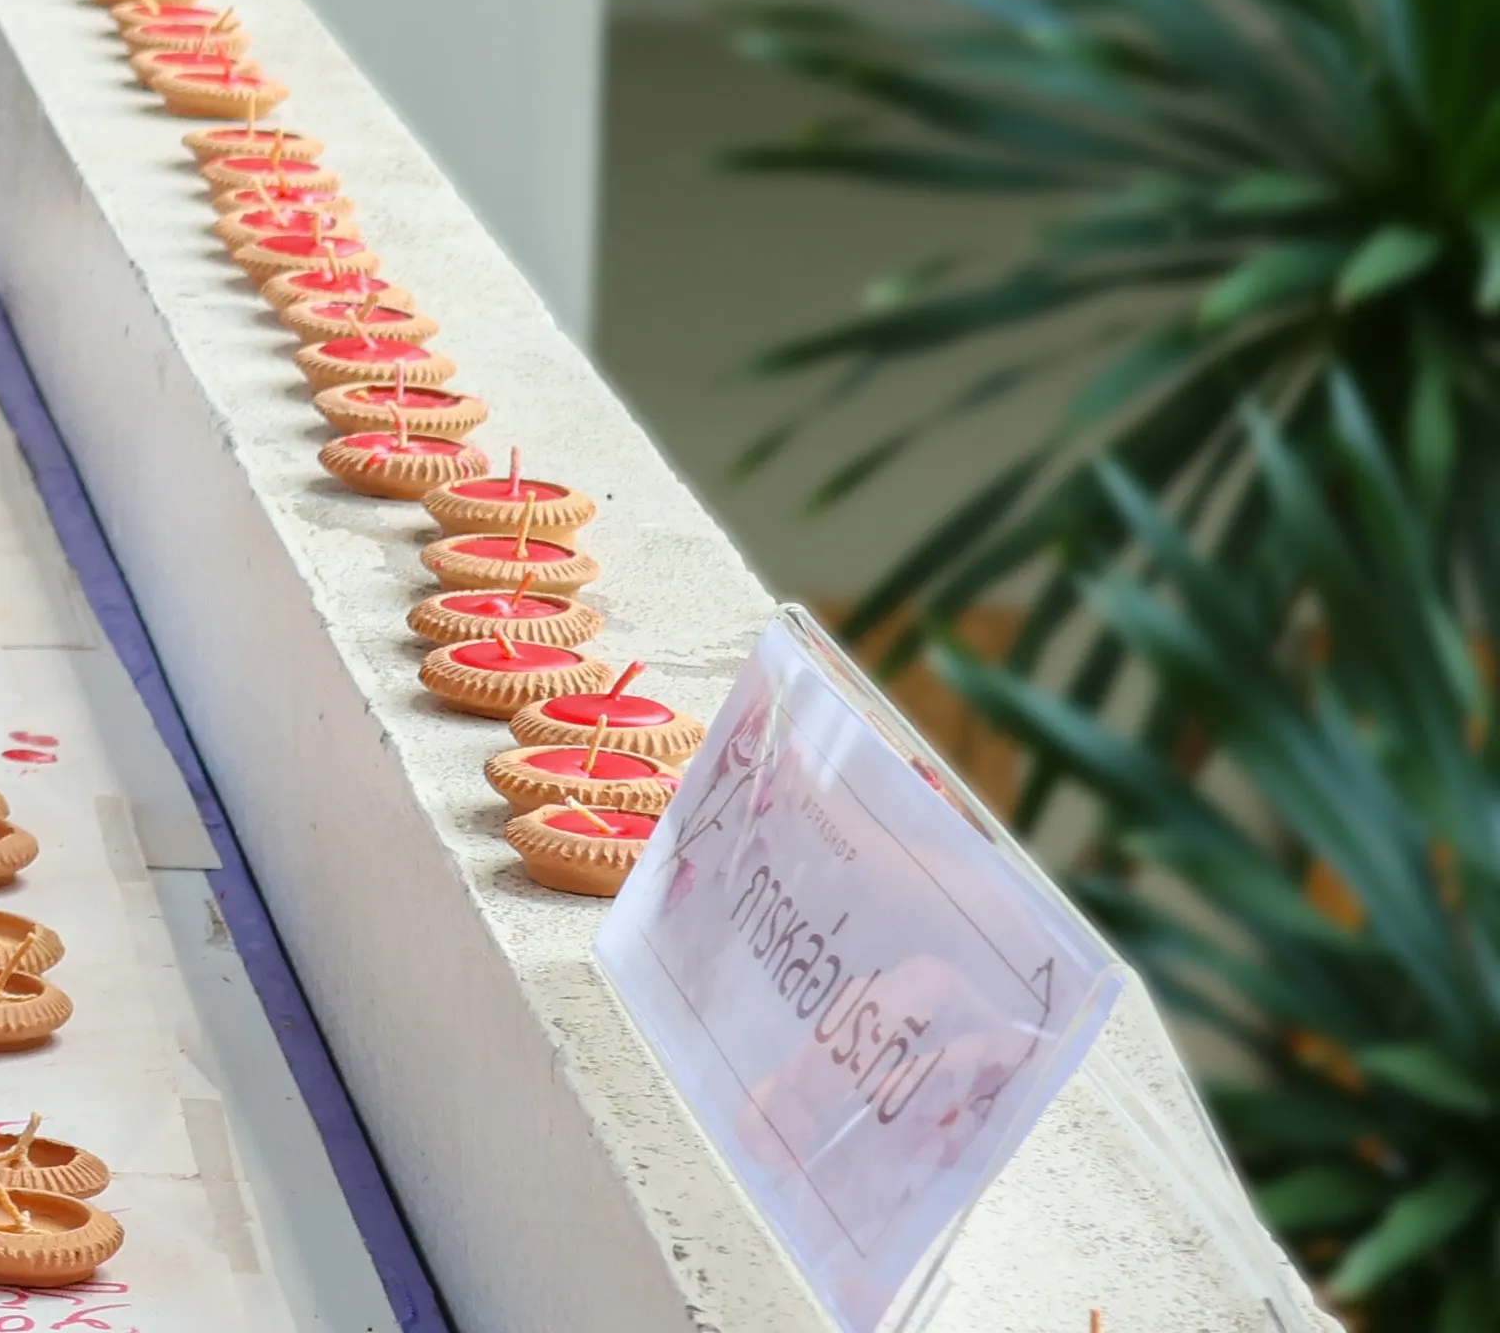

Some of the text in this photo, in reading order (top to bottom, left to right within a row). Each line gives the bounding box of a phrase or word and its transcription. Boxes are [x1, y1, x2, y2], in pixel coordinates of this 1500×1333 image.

[800, 793, 858, 865] WORKSHOP
[729, 864, 946, 1125] การหล่อประทีป
